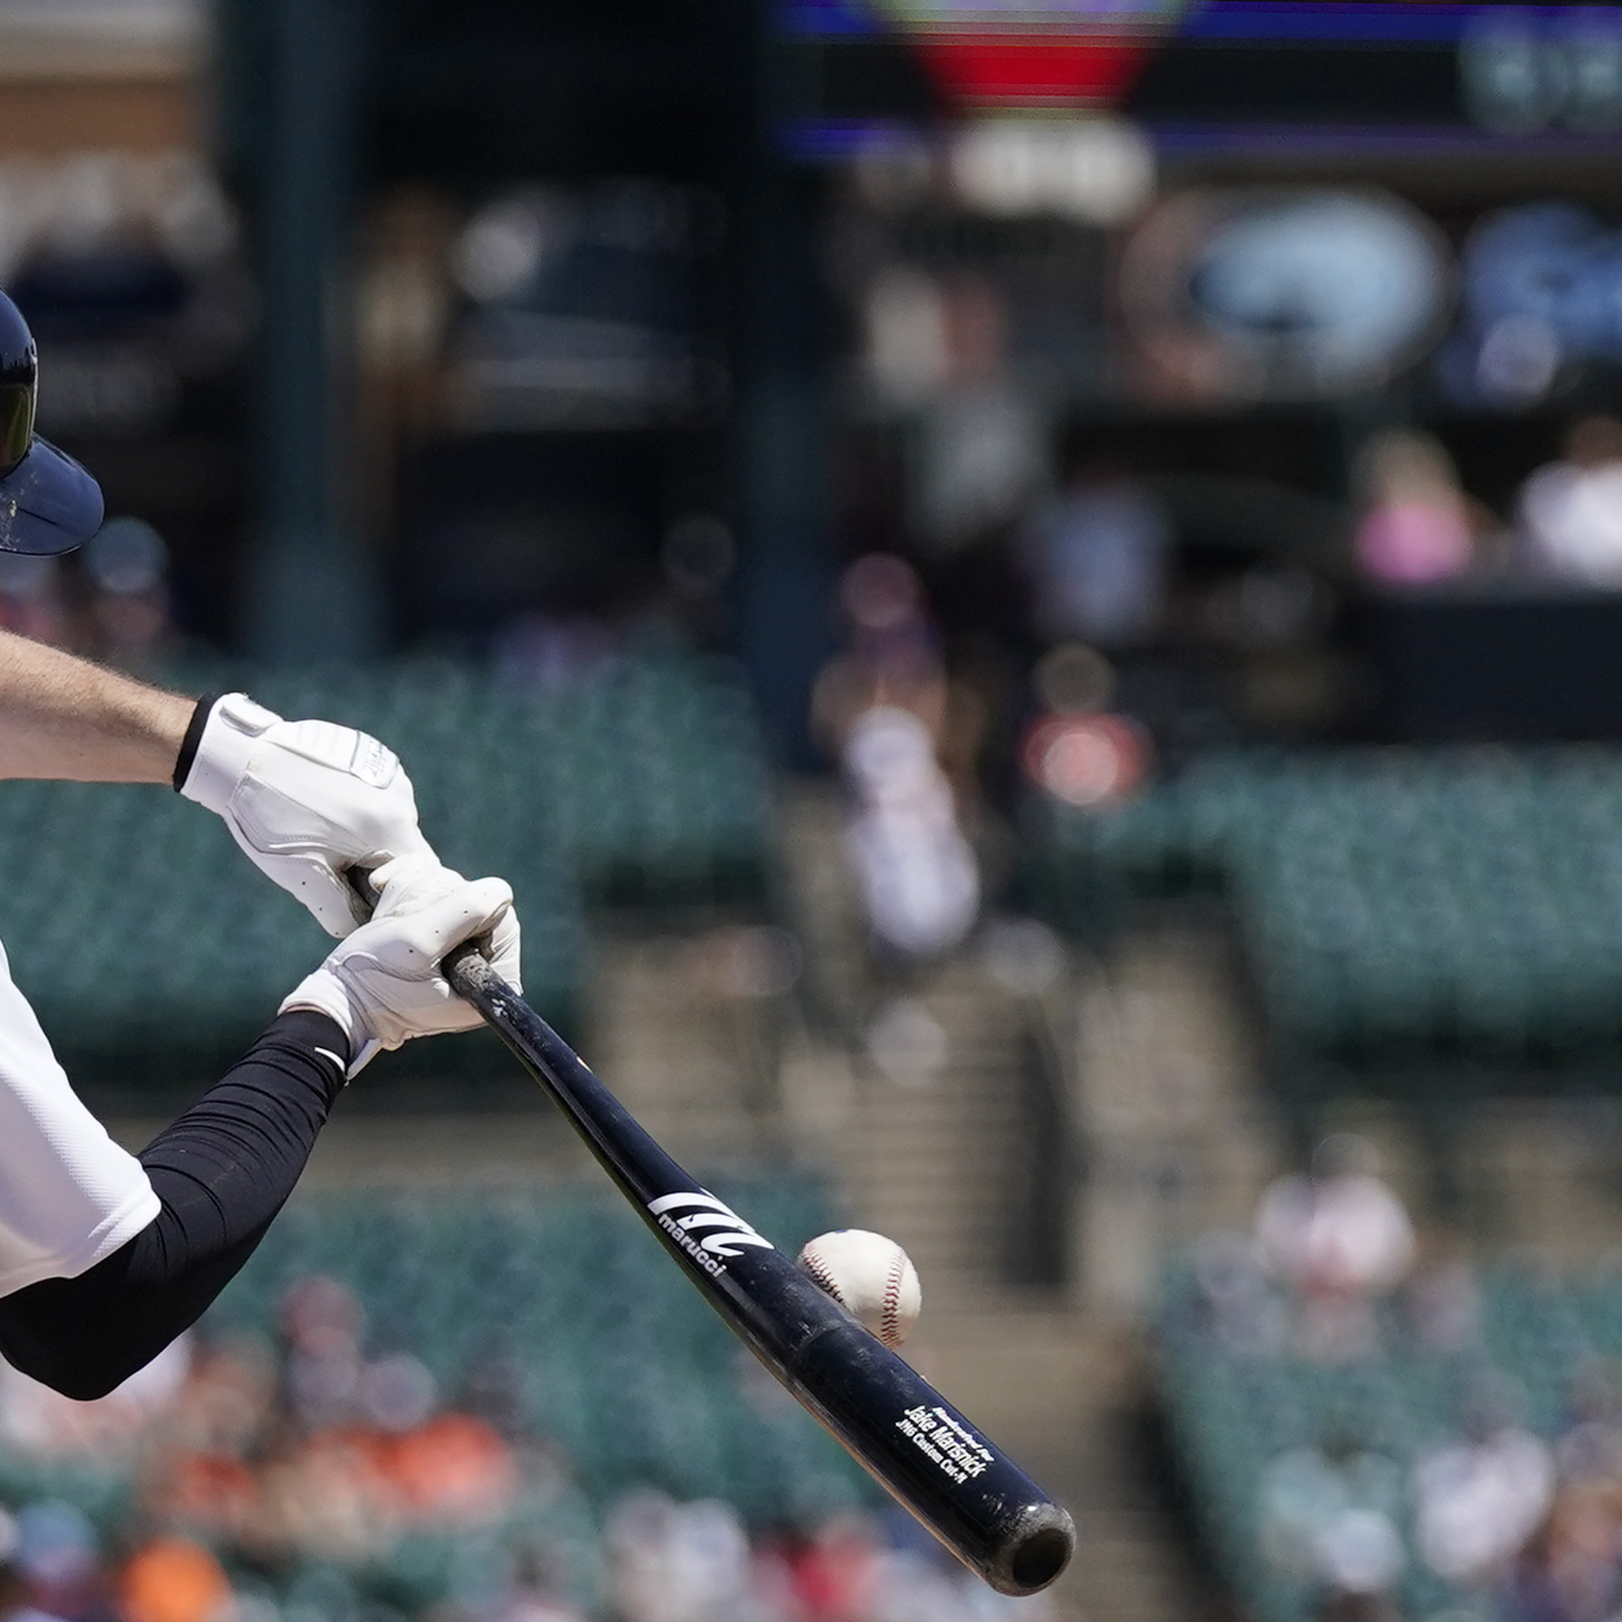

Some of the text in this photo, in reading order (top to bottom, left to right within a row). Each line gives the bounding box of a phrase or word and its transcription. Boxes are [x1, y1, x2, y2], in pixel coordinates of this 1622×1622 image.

[657, 1212, 728, 1279] marucci
[903, 1405, 987, 1478] Jake Marisnick
[912, 1432, 944, 1464] Custom
